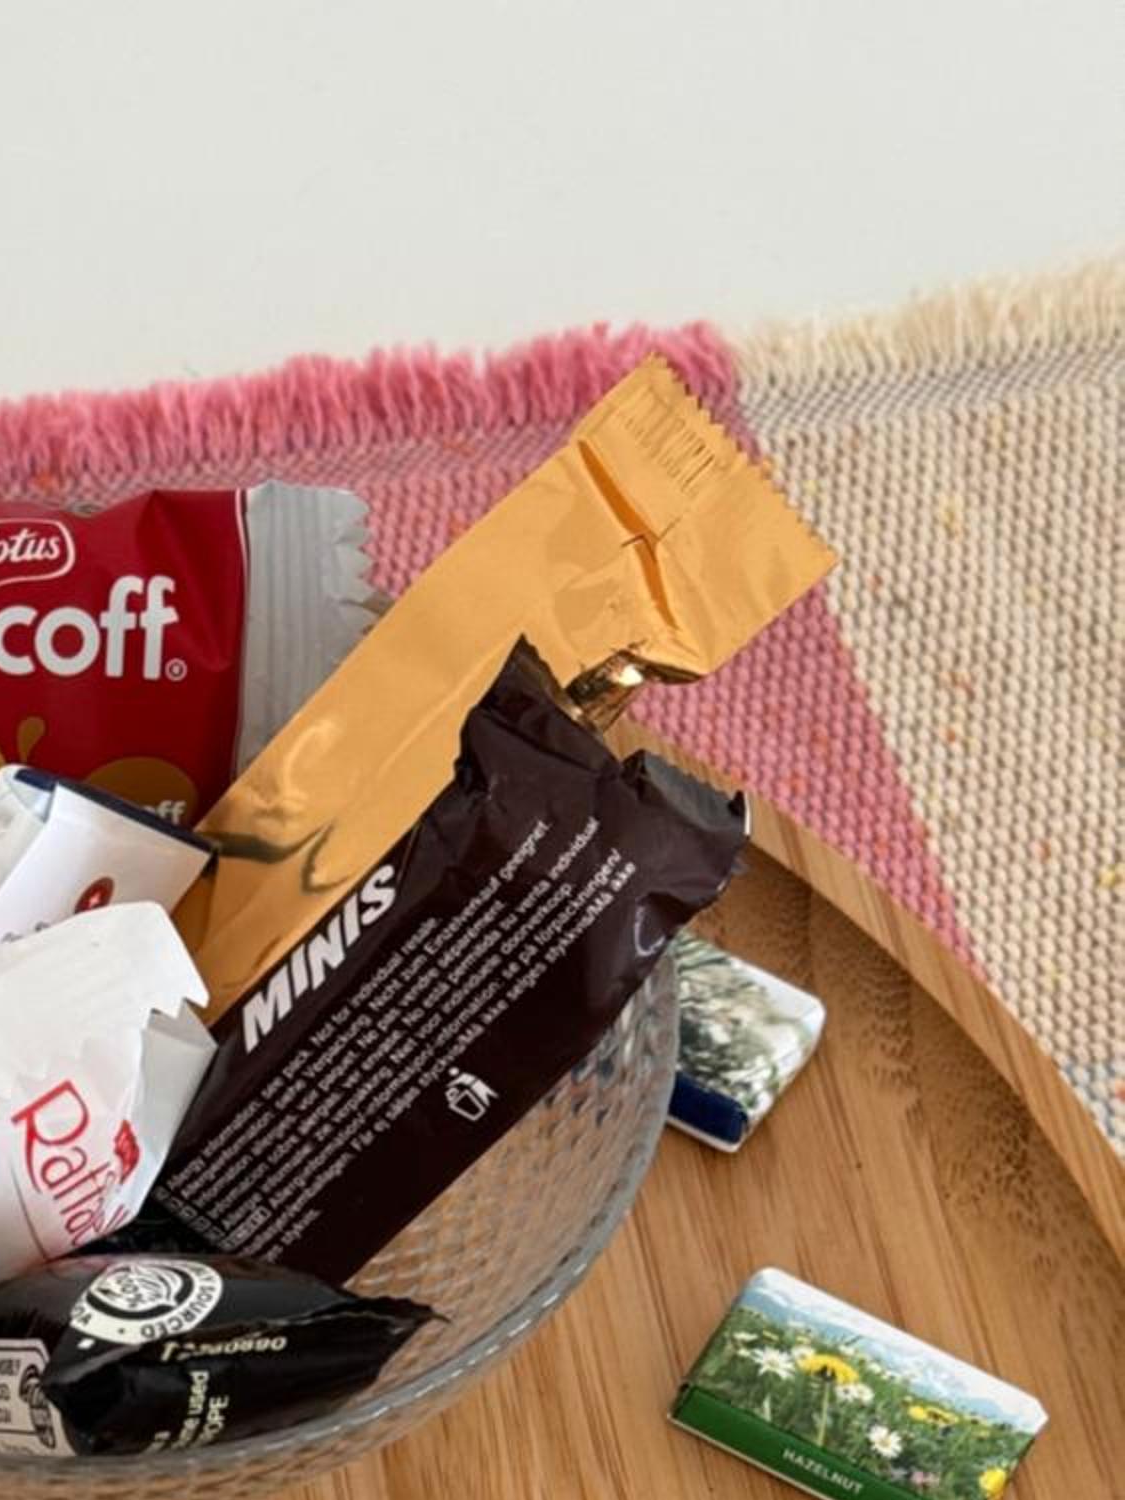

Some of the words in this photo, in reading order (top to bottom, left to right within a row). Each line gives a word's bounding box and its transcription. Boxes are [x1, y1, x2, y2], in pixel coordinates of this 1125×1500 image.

[367, 976, 405, 1013] Nicht
[398, 951, 430, 982] zum
[422, 874, 503, 957] Einzelverkauf
[496, 814, 553, 884] geeignet.
[400, 1003, 426, 1028] No
[497, 911, 519, 932] su
[511, 876, 553, 916] venta
[545, 813, 602, 881] individual
[503, 958, 551, 1004] selges
[606, 859, 640, 893] ikke
[241, 863, 398, 1055] MINIS
[500, 959, 522, 981] se
[309, 1020, 336, 1047] Not
[329, 1003, 353, 1026] for
[345, 950, 406, 1009] individual
[355, 1026, 380, 1051] Ne
[388, 1034, 420, 1065] Niet
[413, 1010, 445, 1041] voor
[140, 1285, 216, 1339] SOURCED
[778, 1447, 866, 1496] HAZELNUT
